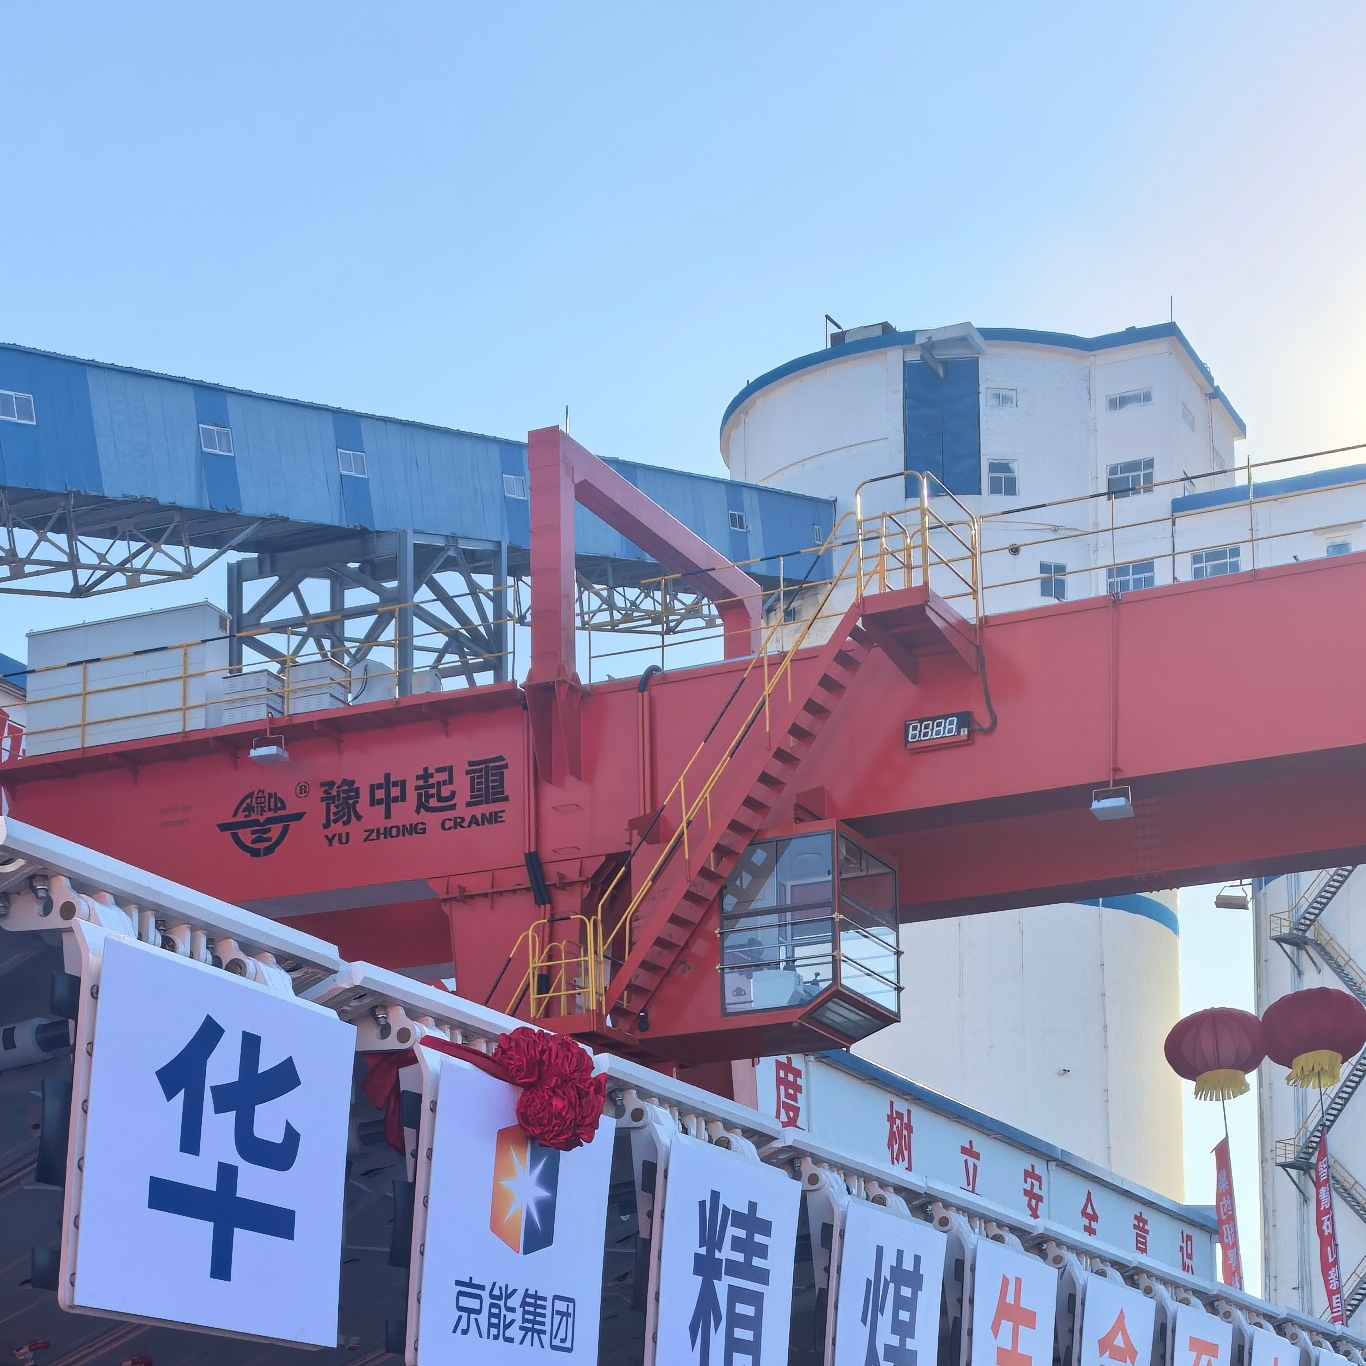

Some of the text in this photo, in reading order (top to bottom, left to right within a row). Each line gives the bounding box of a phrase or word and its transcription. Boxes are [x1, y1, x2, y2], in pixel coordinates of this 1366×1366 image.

[320, 754, 510, 830] 豫中起重
[324, 810, 506, 847] YU ZHONG CRANE
[452, 1276, 576, 1353] 京能集团
